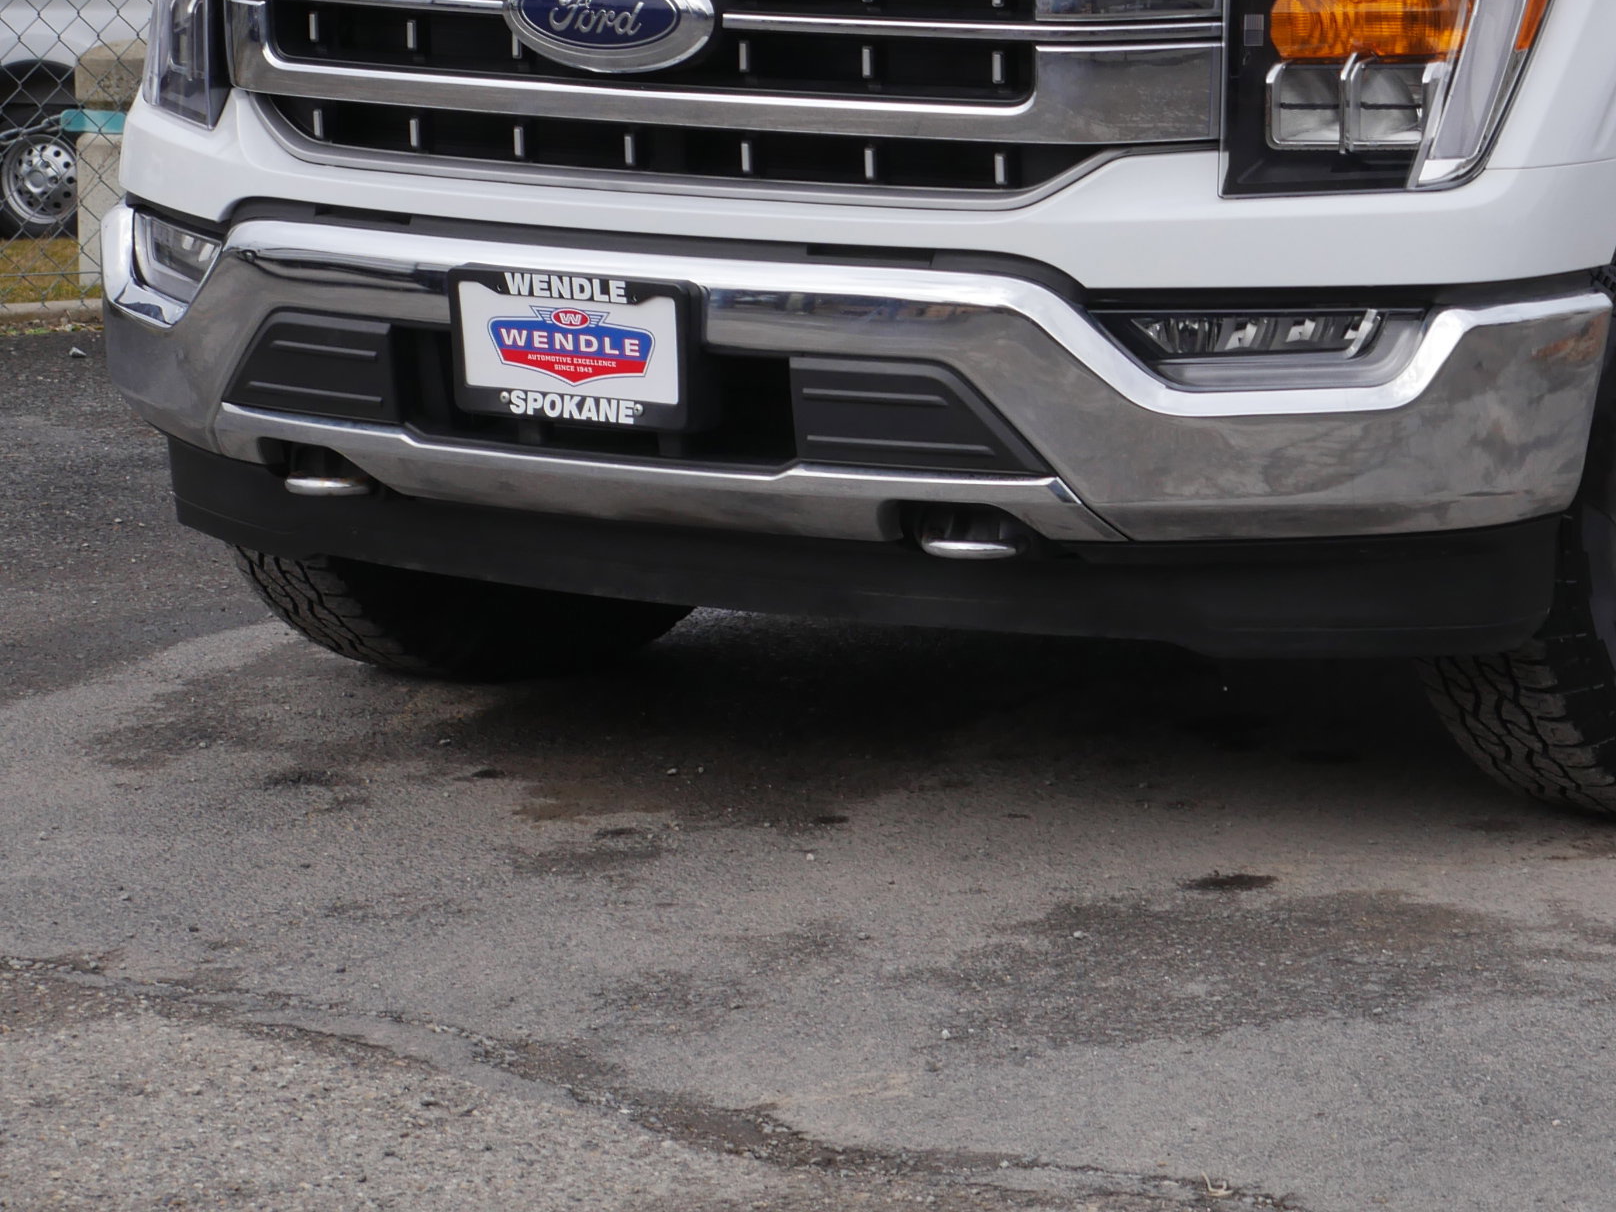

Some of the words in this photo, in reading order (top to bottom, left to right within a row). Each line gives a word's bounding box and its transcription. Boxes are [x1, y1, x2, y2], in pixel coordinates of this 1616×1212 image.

[504, 272, 629, 304] WENDLE
[559, 312, 582, 326] W
[500, 328, 641, 357] WENDLE
[527, 353, 572, 364] AUTOMOTIVE
[573, 357, 617, 368] EXCELLENCE
[553, 364, 575, 372] SINCE
[509, 390, 635, 425] SPOKANE
